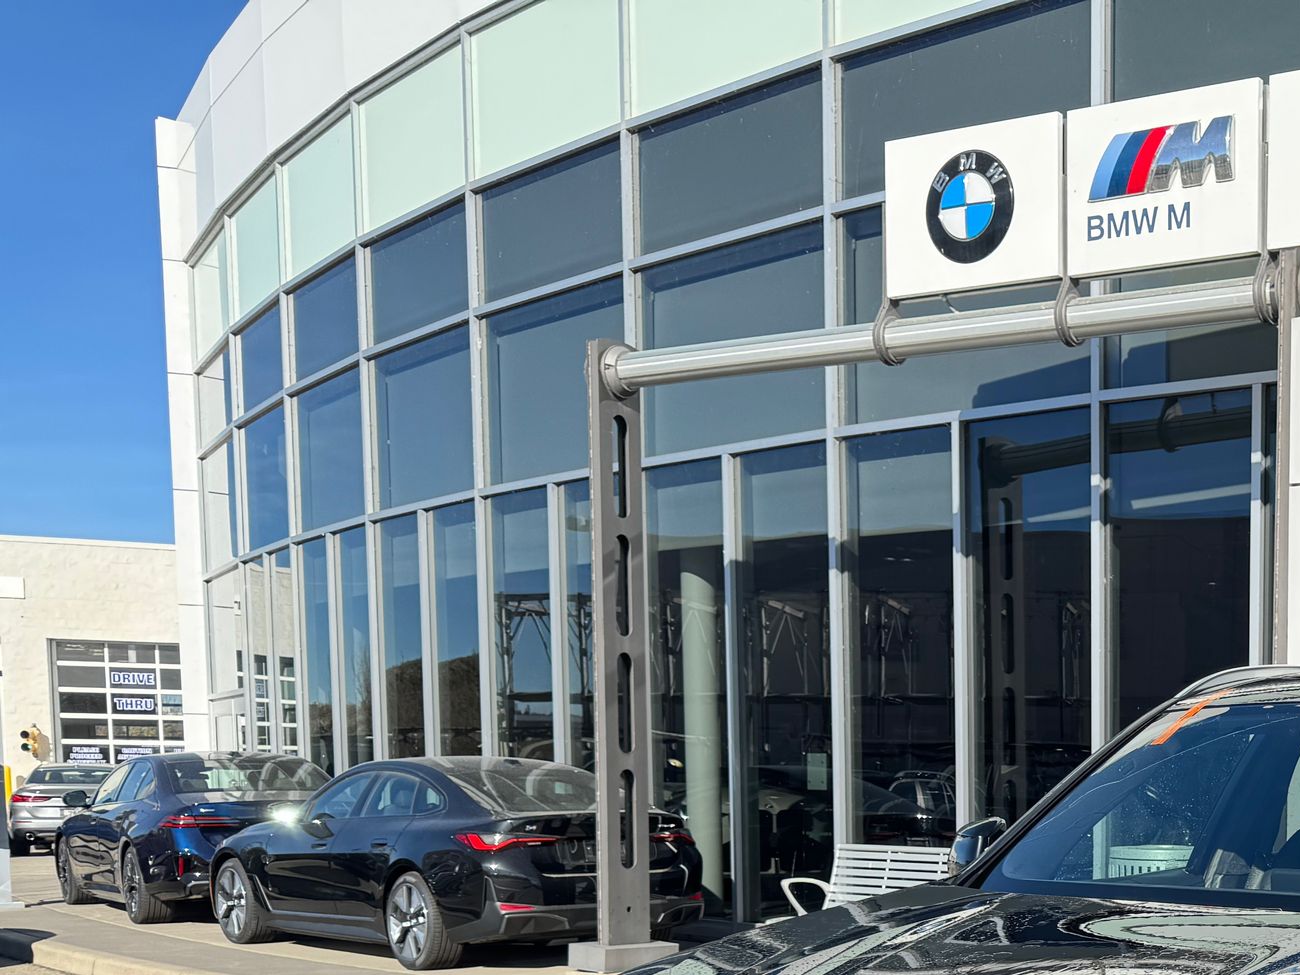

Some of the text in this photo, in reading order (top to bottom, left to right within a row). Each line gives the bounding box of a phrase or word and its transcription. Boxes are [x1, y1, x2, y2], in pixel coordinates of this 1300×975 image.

[932, 152, 1007, 192] BMW
[1087, 202, 1191, 241] BMW M
[111, 672, 155, 685] DRIVE
[114, 698, 154, 711] THRU
